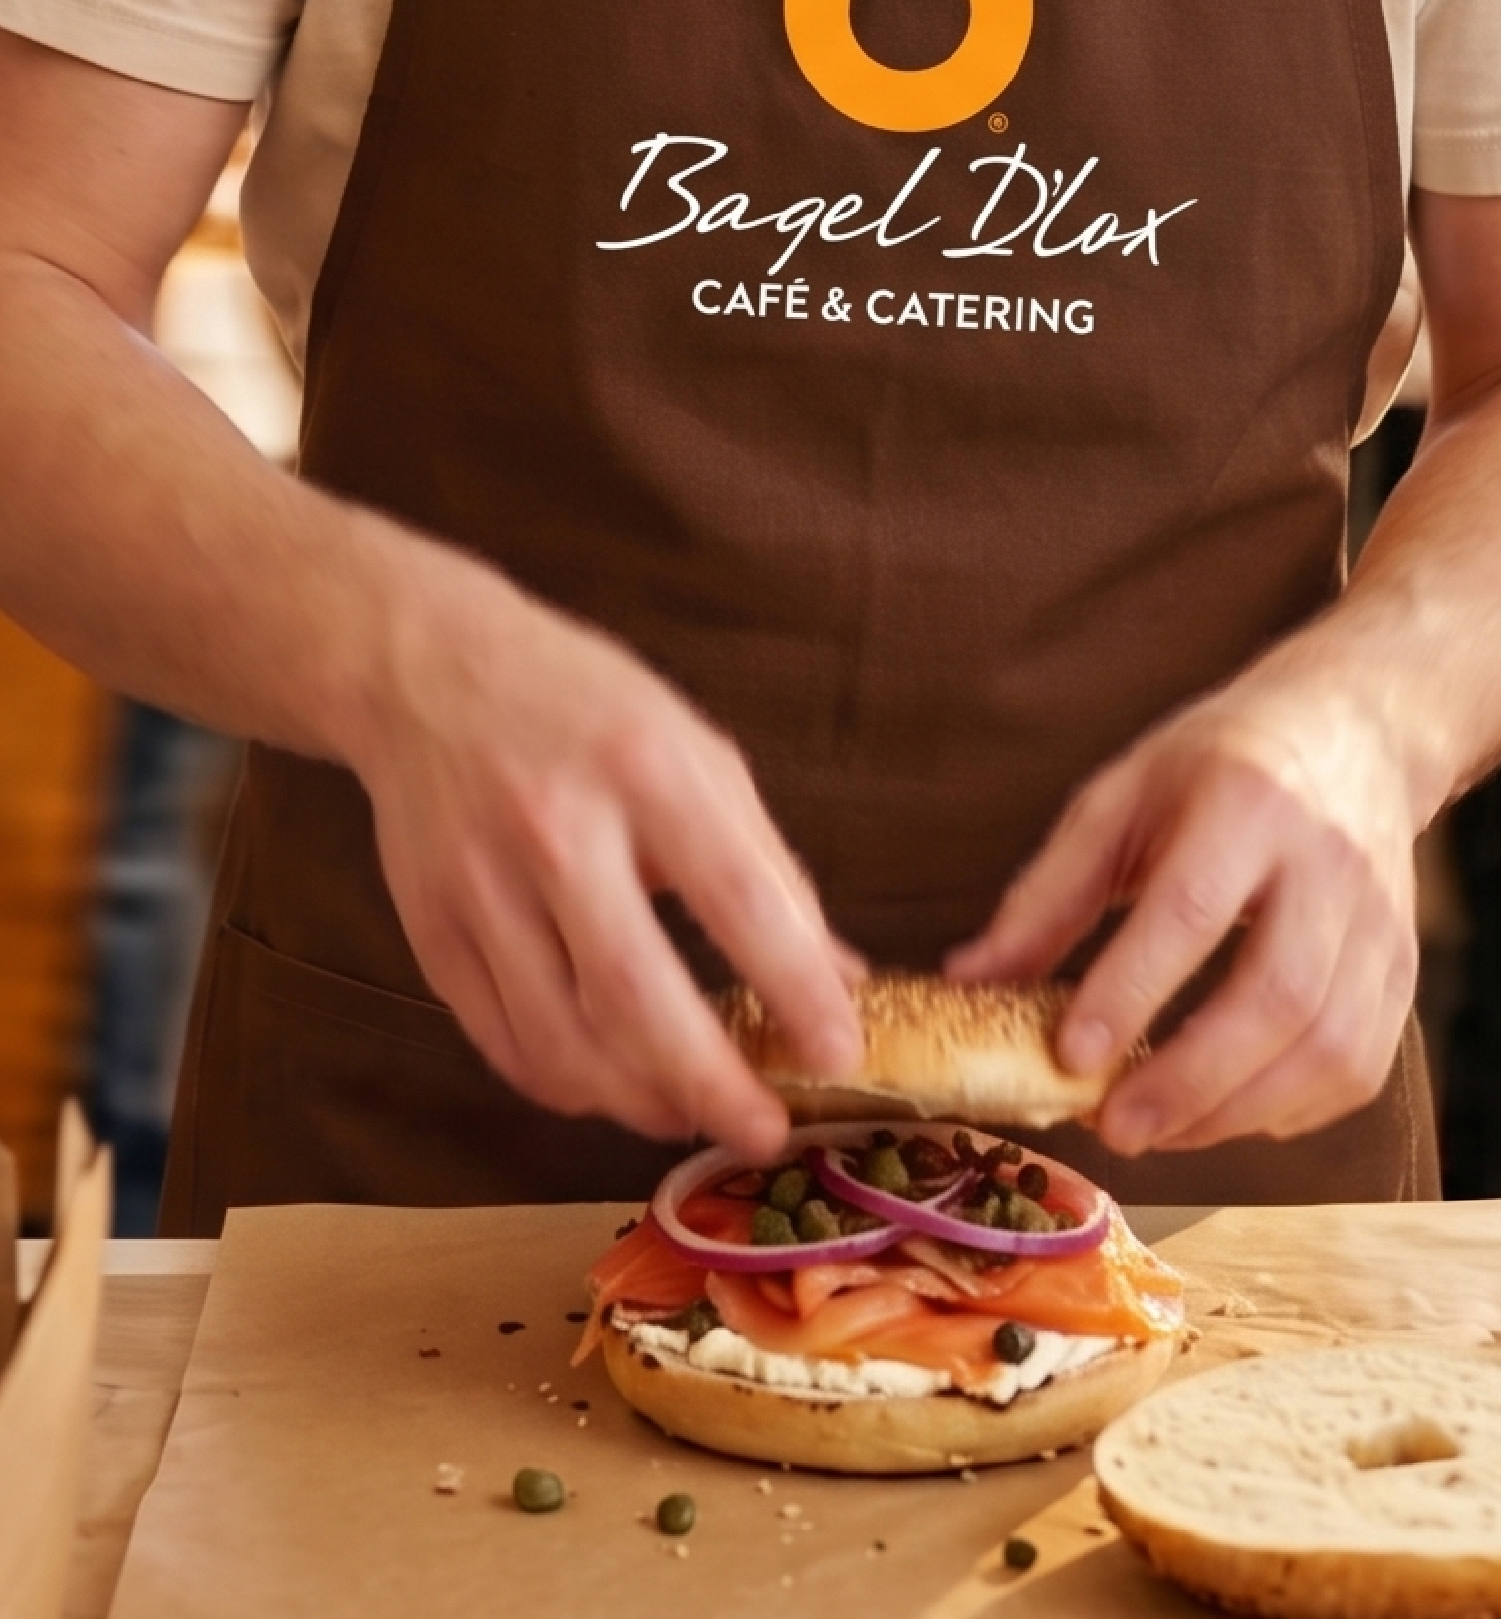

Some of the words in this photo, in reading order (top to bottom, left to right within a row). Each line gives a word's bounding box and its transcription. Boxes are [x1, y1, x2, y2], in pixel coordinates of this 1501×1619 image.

[595, 131, 942, 277] Bagel
[691, 276, 810, 321] CAFÉ
[821, 286, 853, 323] &
[865, 288, 1096, 336] CATERING
